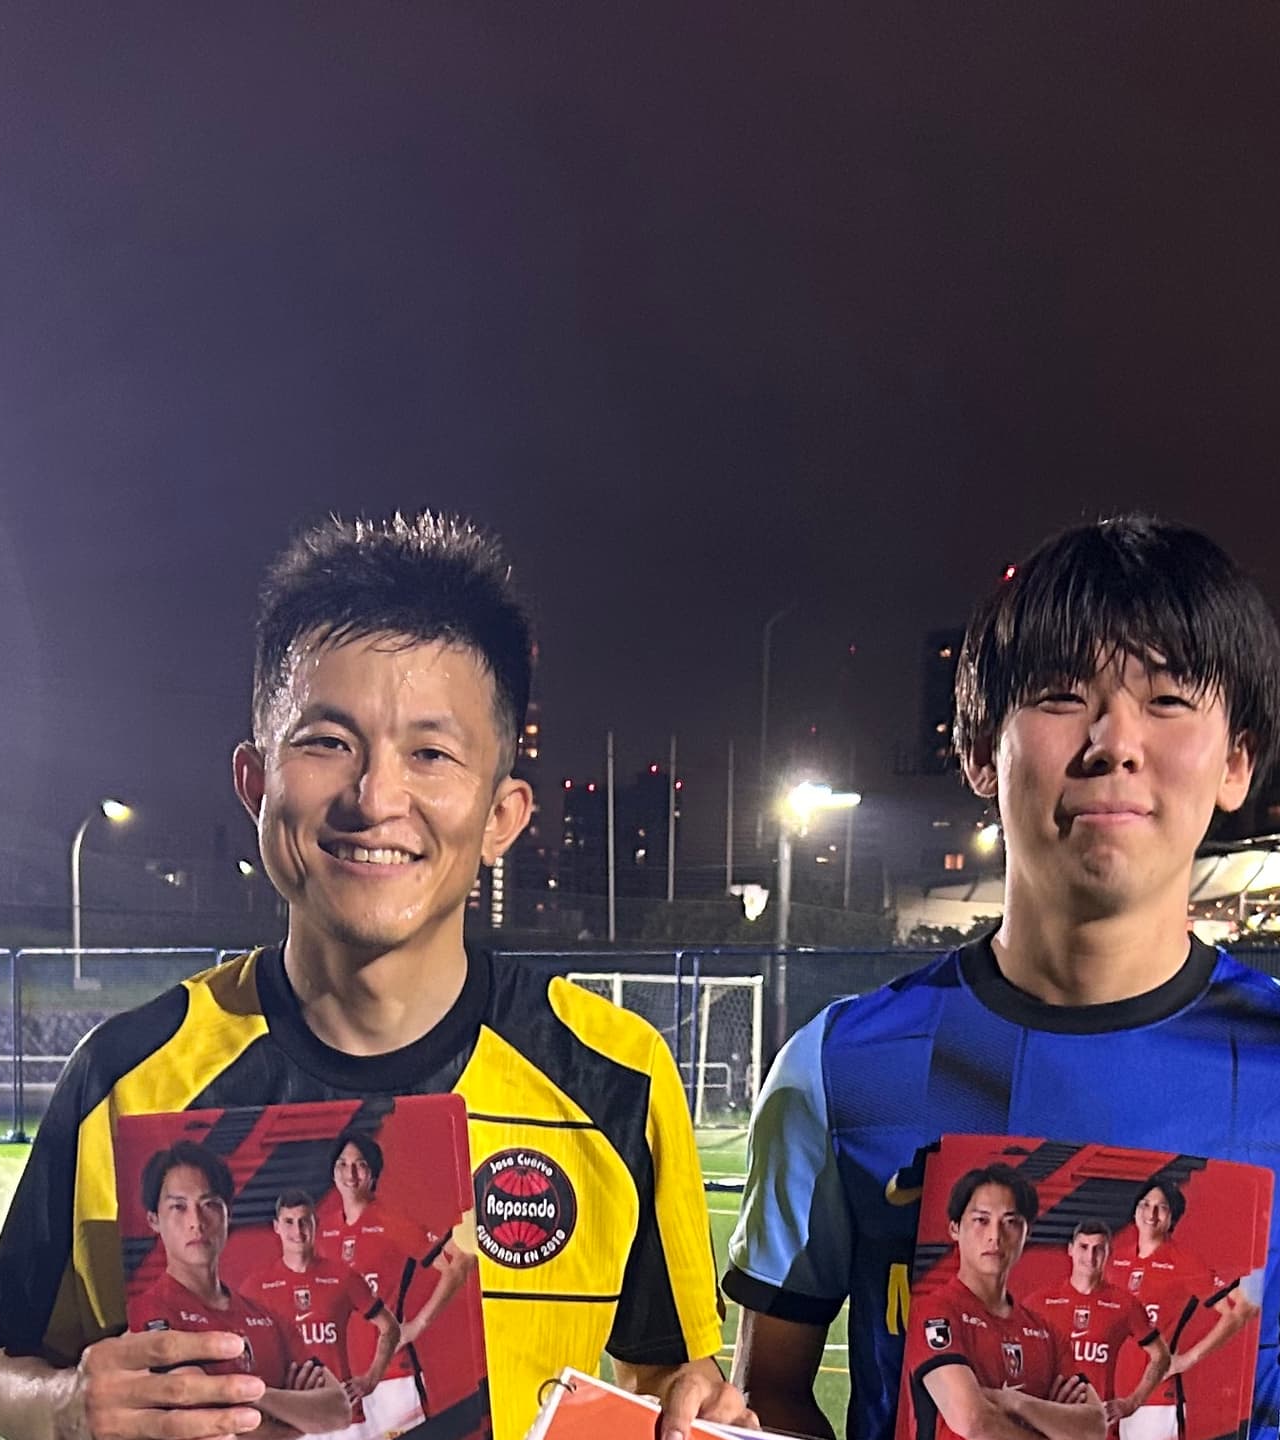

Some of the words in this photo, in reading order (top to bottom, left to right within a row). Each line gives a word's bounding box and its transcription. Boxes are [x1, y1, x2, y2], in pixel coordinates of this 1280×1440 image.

[487, 1194, 555, 1221] Reposado
[299, 1322, 338, 1345] LUS
[1071, 1340, 1109, 1363] LUS
